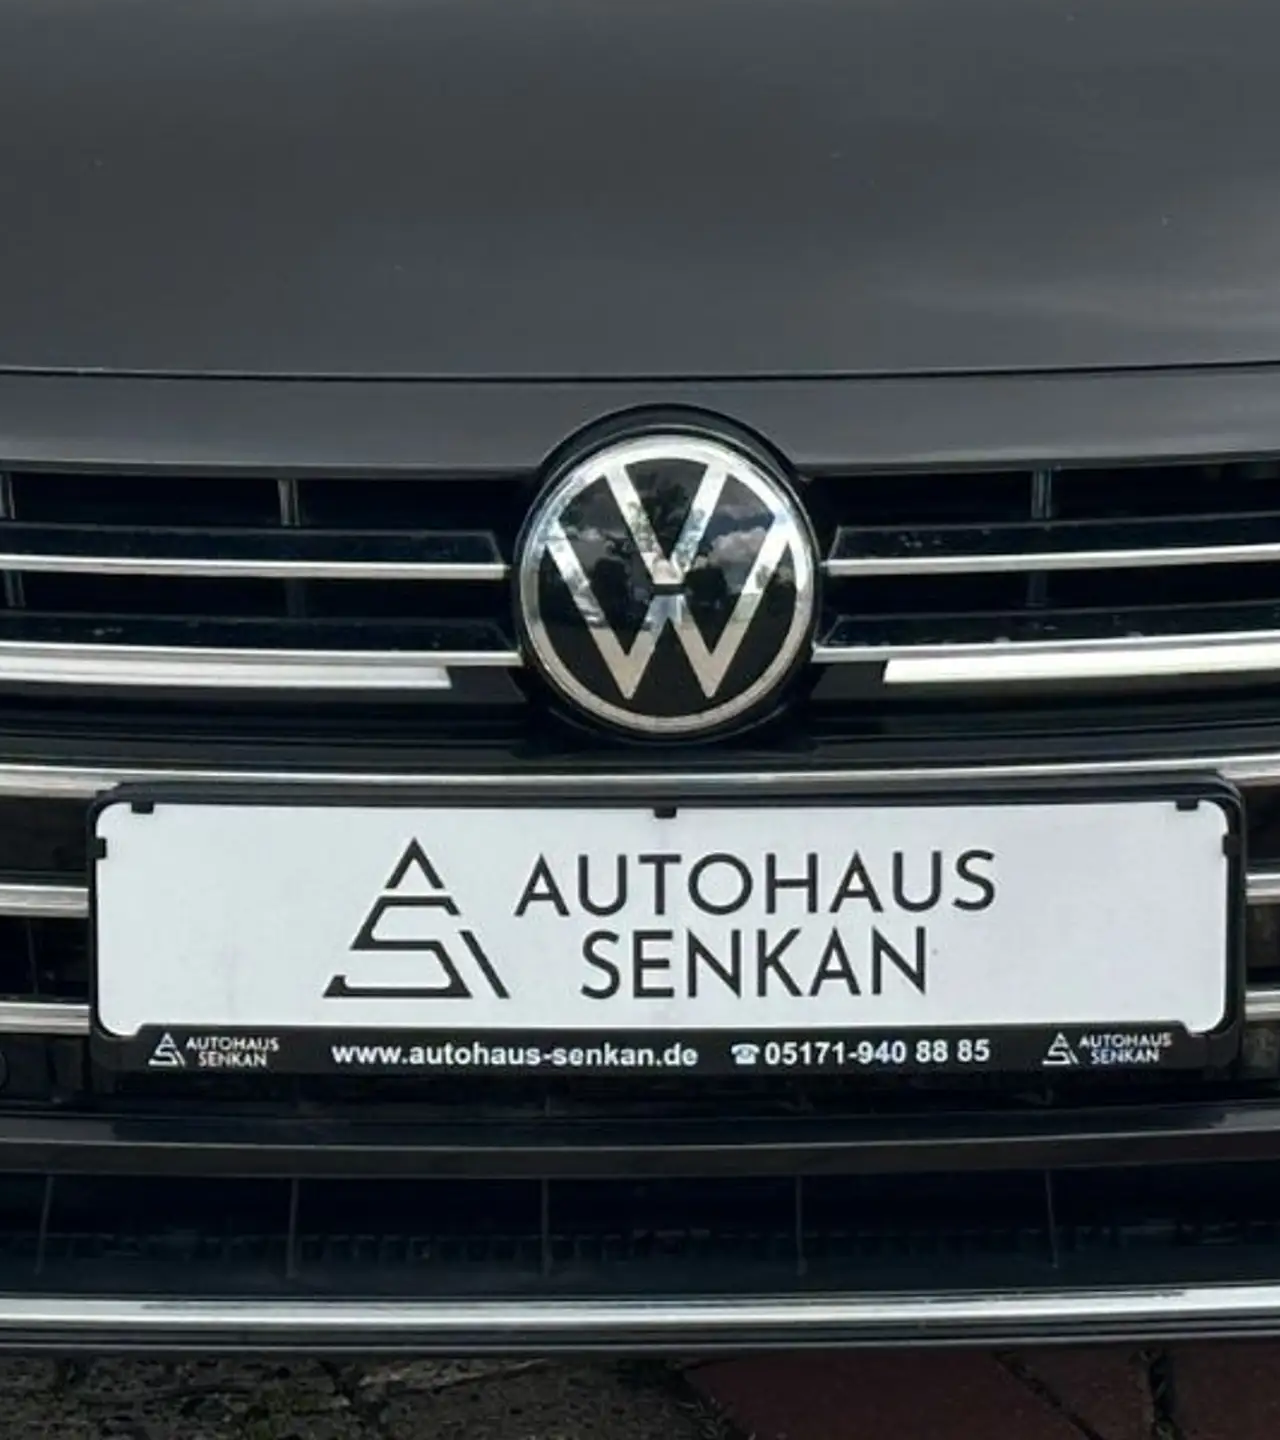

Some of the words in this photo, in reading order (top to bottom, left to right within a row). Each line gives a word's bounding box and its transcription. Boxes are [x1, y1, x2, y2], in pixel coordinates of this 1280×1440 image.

[538, 453, 796, 704] VW
[514, 849, 995, 917] AUTOHAUS
[580, 926, 926, 1000] SENKAN
[185, 1036, 280, 1051] AUTOHAUS
[764, 1041, 907, 1066] 05171-940
[915, 1040, 948, 1063] 88
[957, 1038, 990, 1062] 85
[1079, 1032, 1173, 1048] AUTOHAUS
[197, 1050, 268, 1068] SENKAN
[331, 1041, 699, 1067] www.autohaus-senkan.de
[1090, 1047, 1160, 1065] SENKAN
